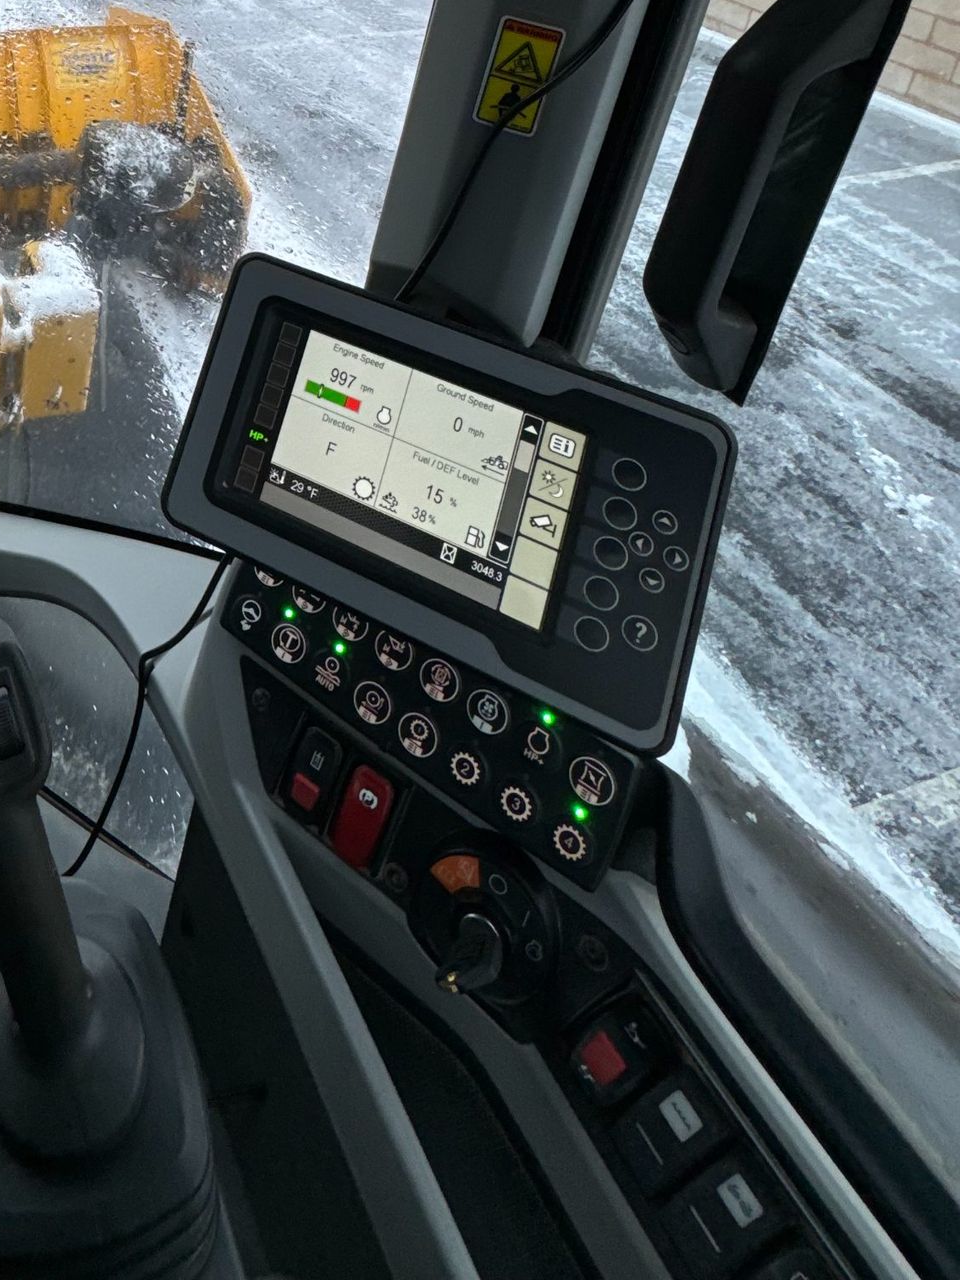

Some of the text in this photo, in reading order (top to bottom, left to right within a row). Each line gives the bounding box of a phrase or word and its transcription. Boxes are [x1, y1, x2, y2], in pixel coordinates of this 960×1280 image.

[333, 343, 385, 370] Engine Speed
[329, 367, 375, 395] 997 rpm
[437, 383, 494, 412] Ground Speed
[322, 413, 356, 434] Direction
[453, 416, 485, 439] 0 mph
[325, 441, 337, 456] F
[412, 450, 431, 465] Fuel
[436, 461, 457, 475] DEF
[457, 470, 480, 486] Level
[290, 479, 304, 493] 29
[426, 484, 458, 508] 15 %
[470, 560, 503, 582] 3048.3
[635, 622, 648, 644] ?
[315, 674, 335, 692] AUTO
[460, 762, 471, 777] 2
[511, 797, 521, 811] 3
[565, 836, 575, 850] 4
